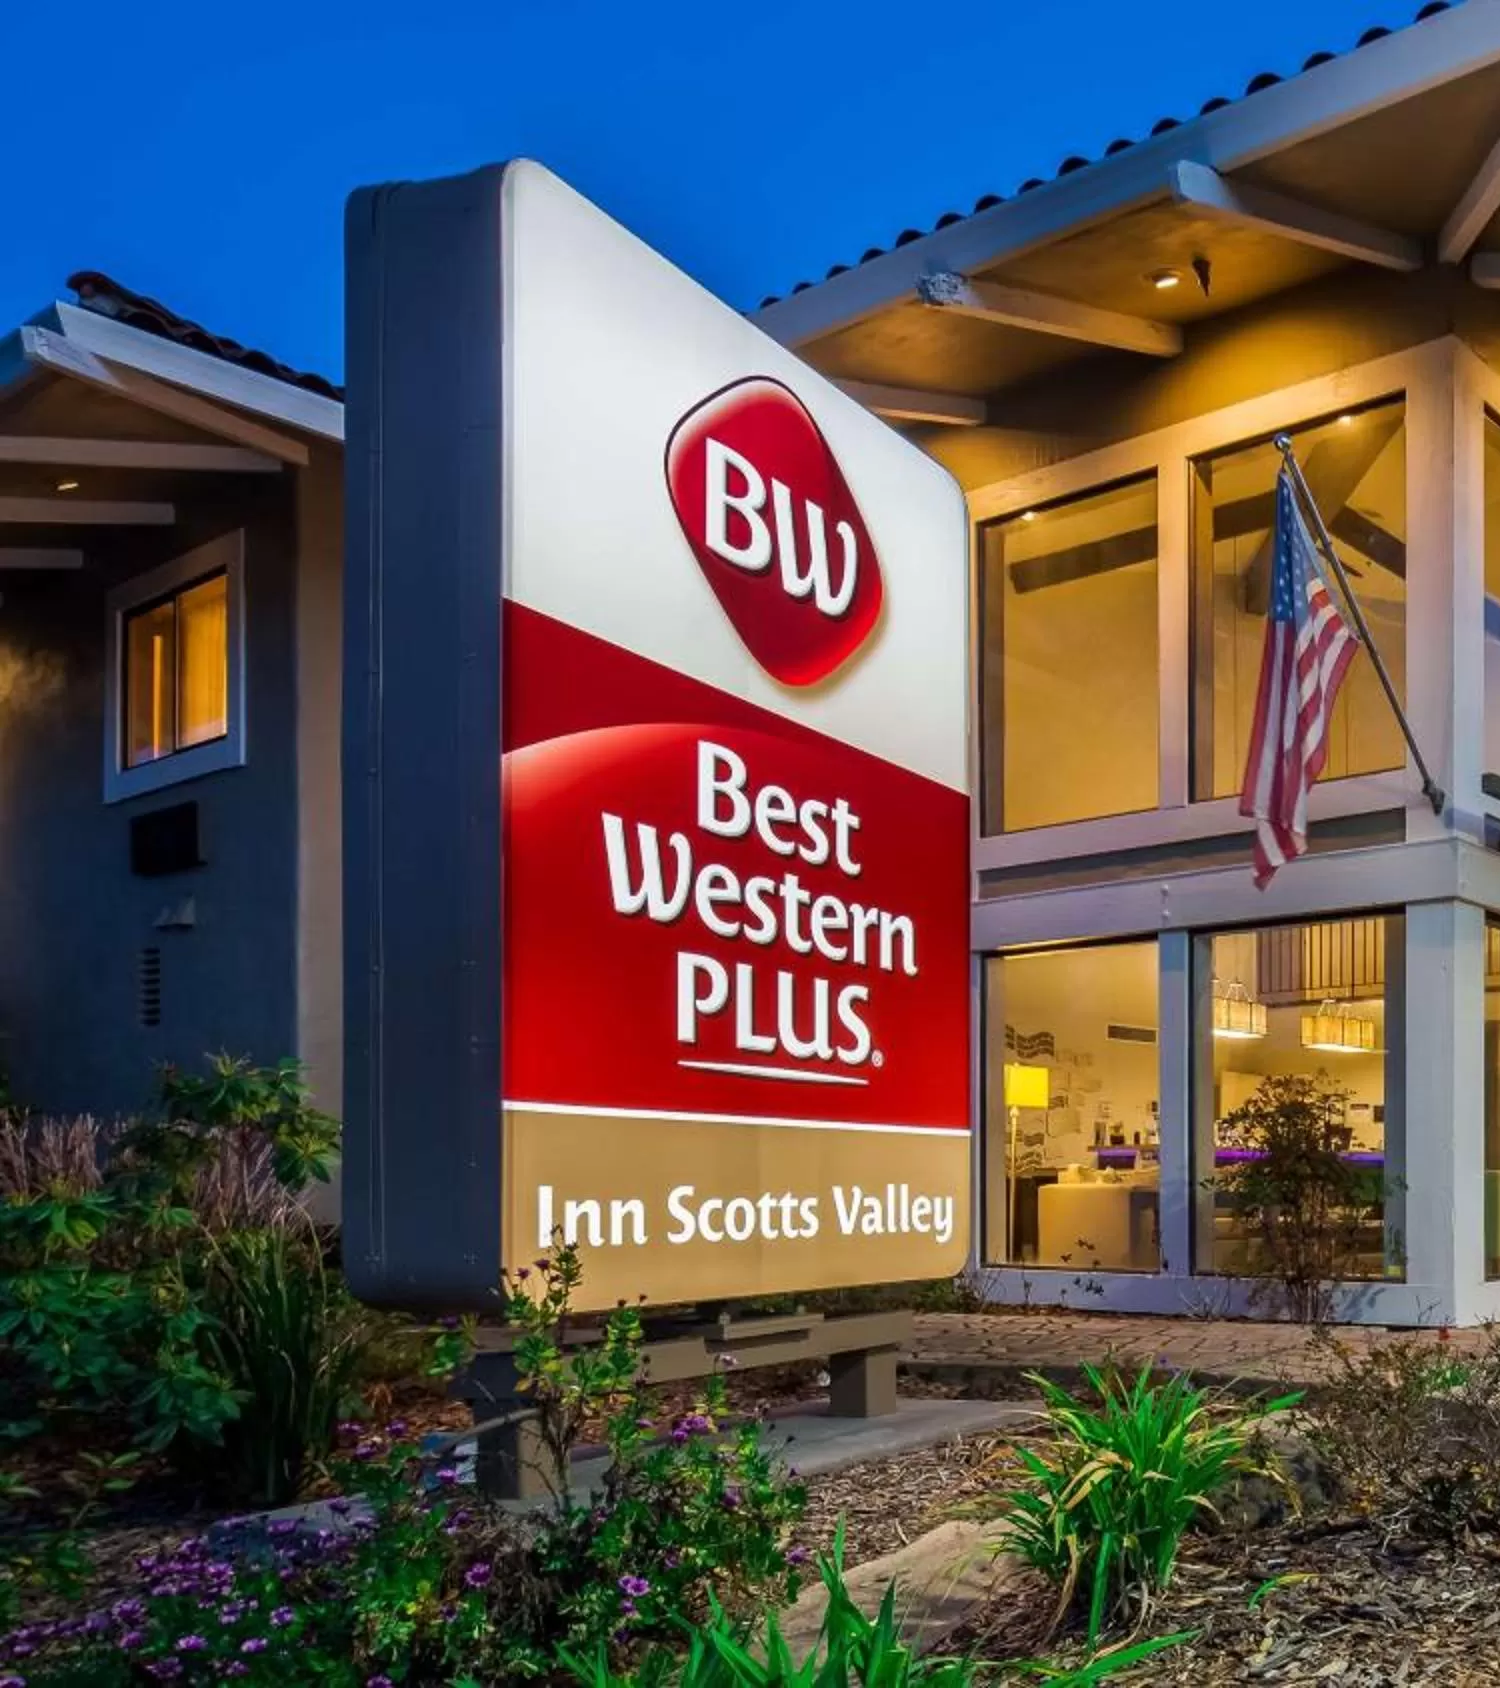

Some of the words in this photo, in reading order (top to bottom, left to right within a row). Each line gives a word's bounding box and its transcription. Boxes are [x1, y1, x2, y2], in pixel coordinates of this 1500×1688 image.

[706, 437, 857, 617] BW
[698, 739, 861, 875] Best
[602, 811, 919, 976] Western
[677, 951, 871, 1065] PLUS
[537, 1185, 649, 1249] Inn
[667, 1185, 820, 1244] Scotts
[832, 1183, 954, 1244] Valley
